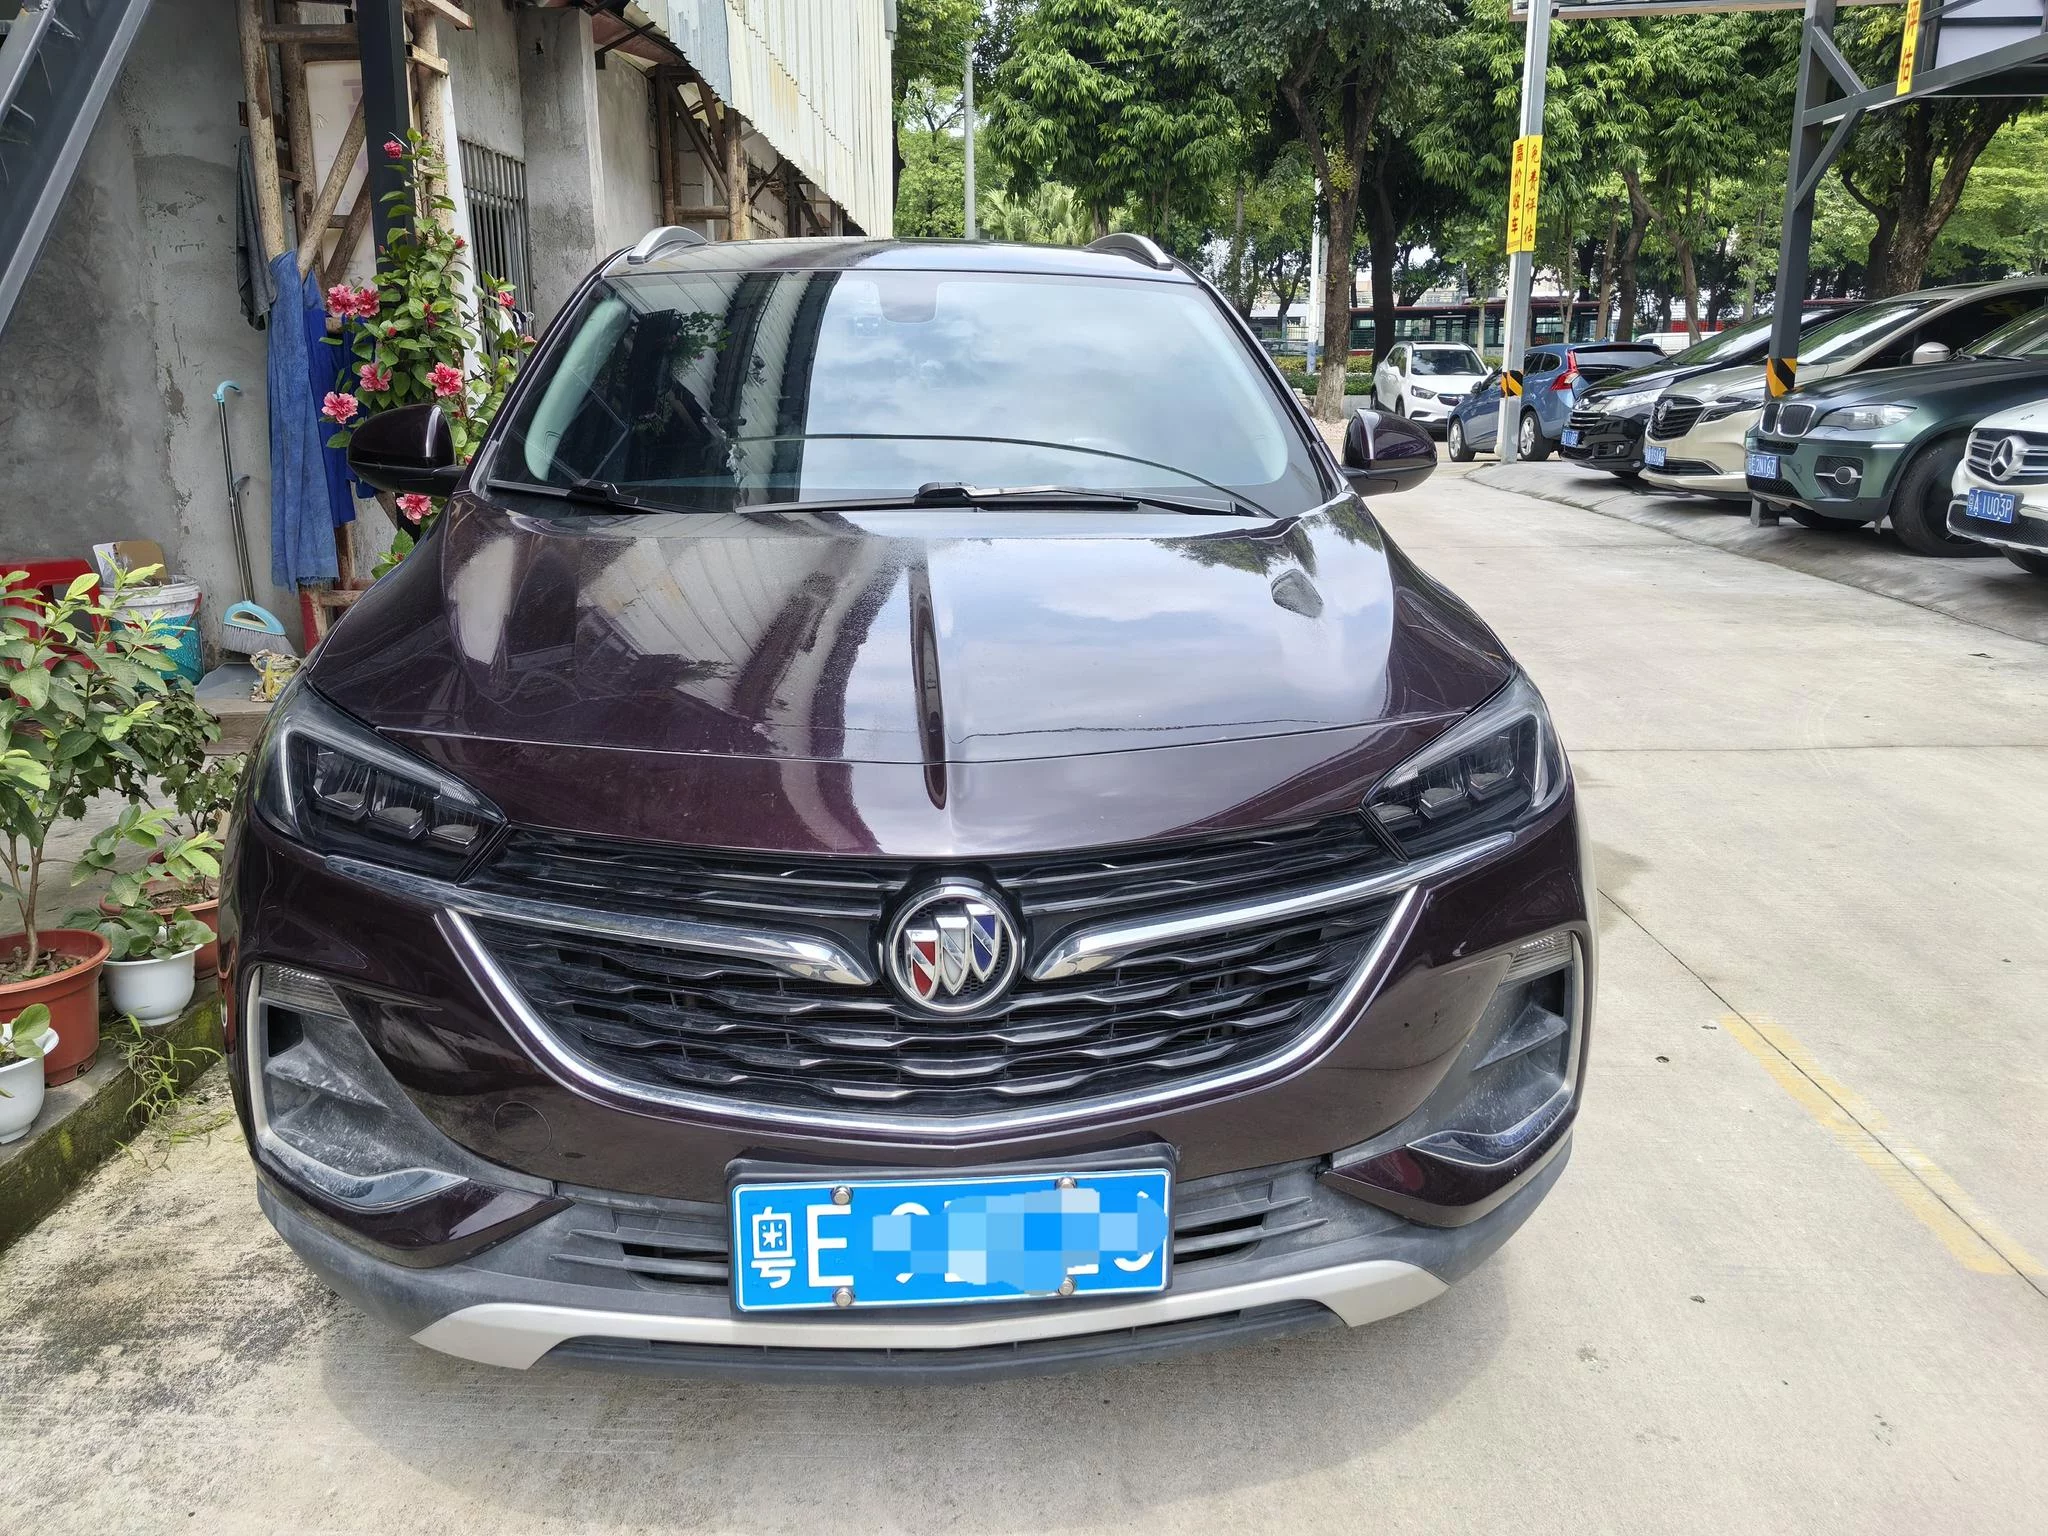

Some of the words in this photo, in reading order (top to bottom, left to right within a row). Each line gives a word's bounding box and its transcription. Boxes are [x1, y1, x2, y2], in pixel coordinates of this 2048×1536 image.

[1511, 143, 1524, 236] 高价收车
[1523, 143, 1540, 243] 免费评估
